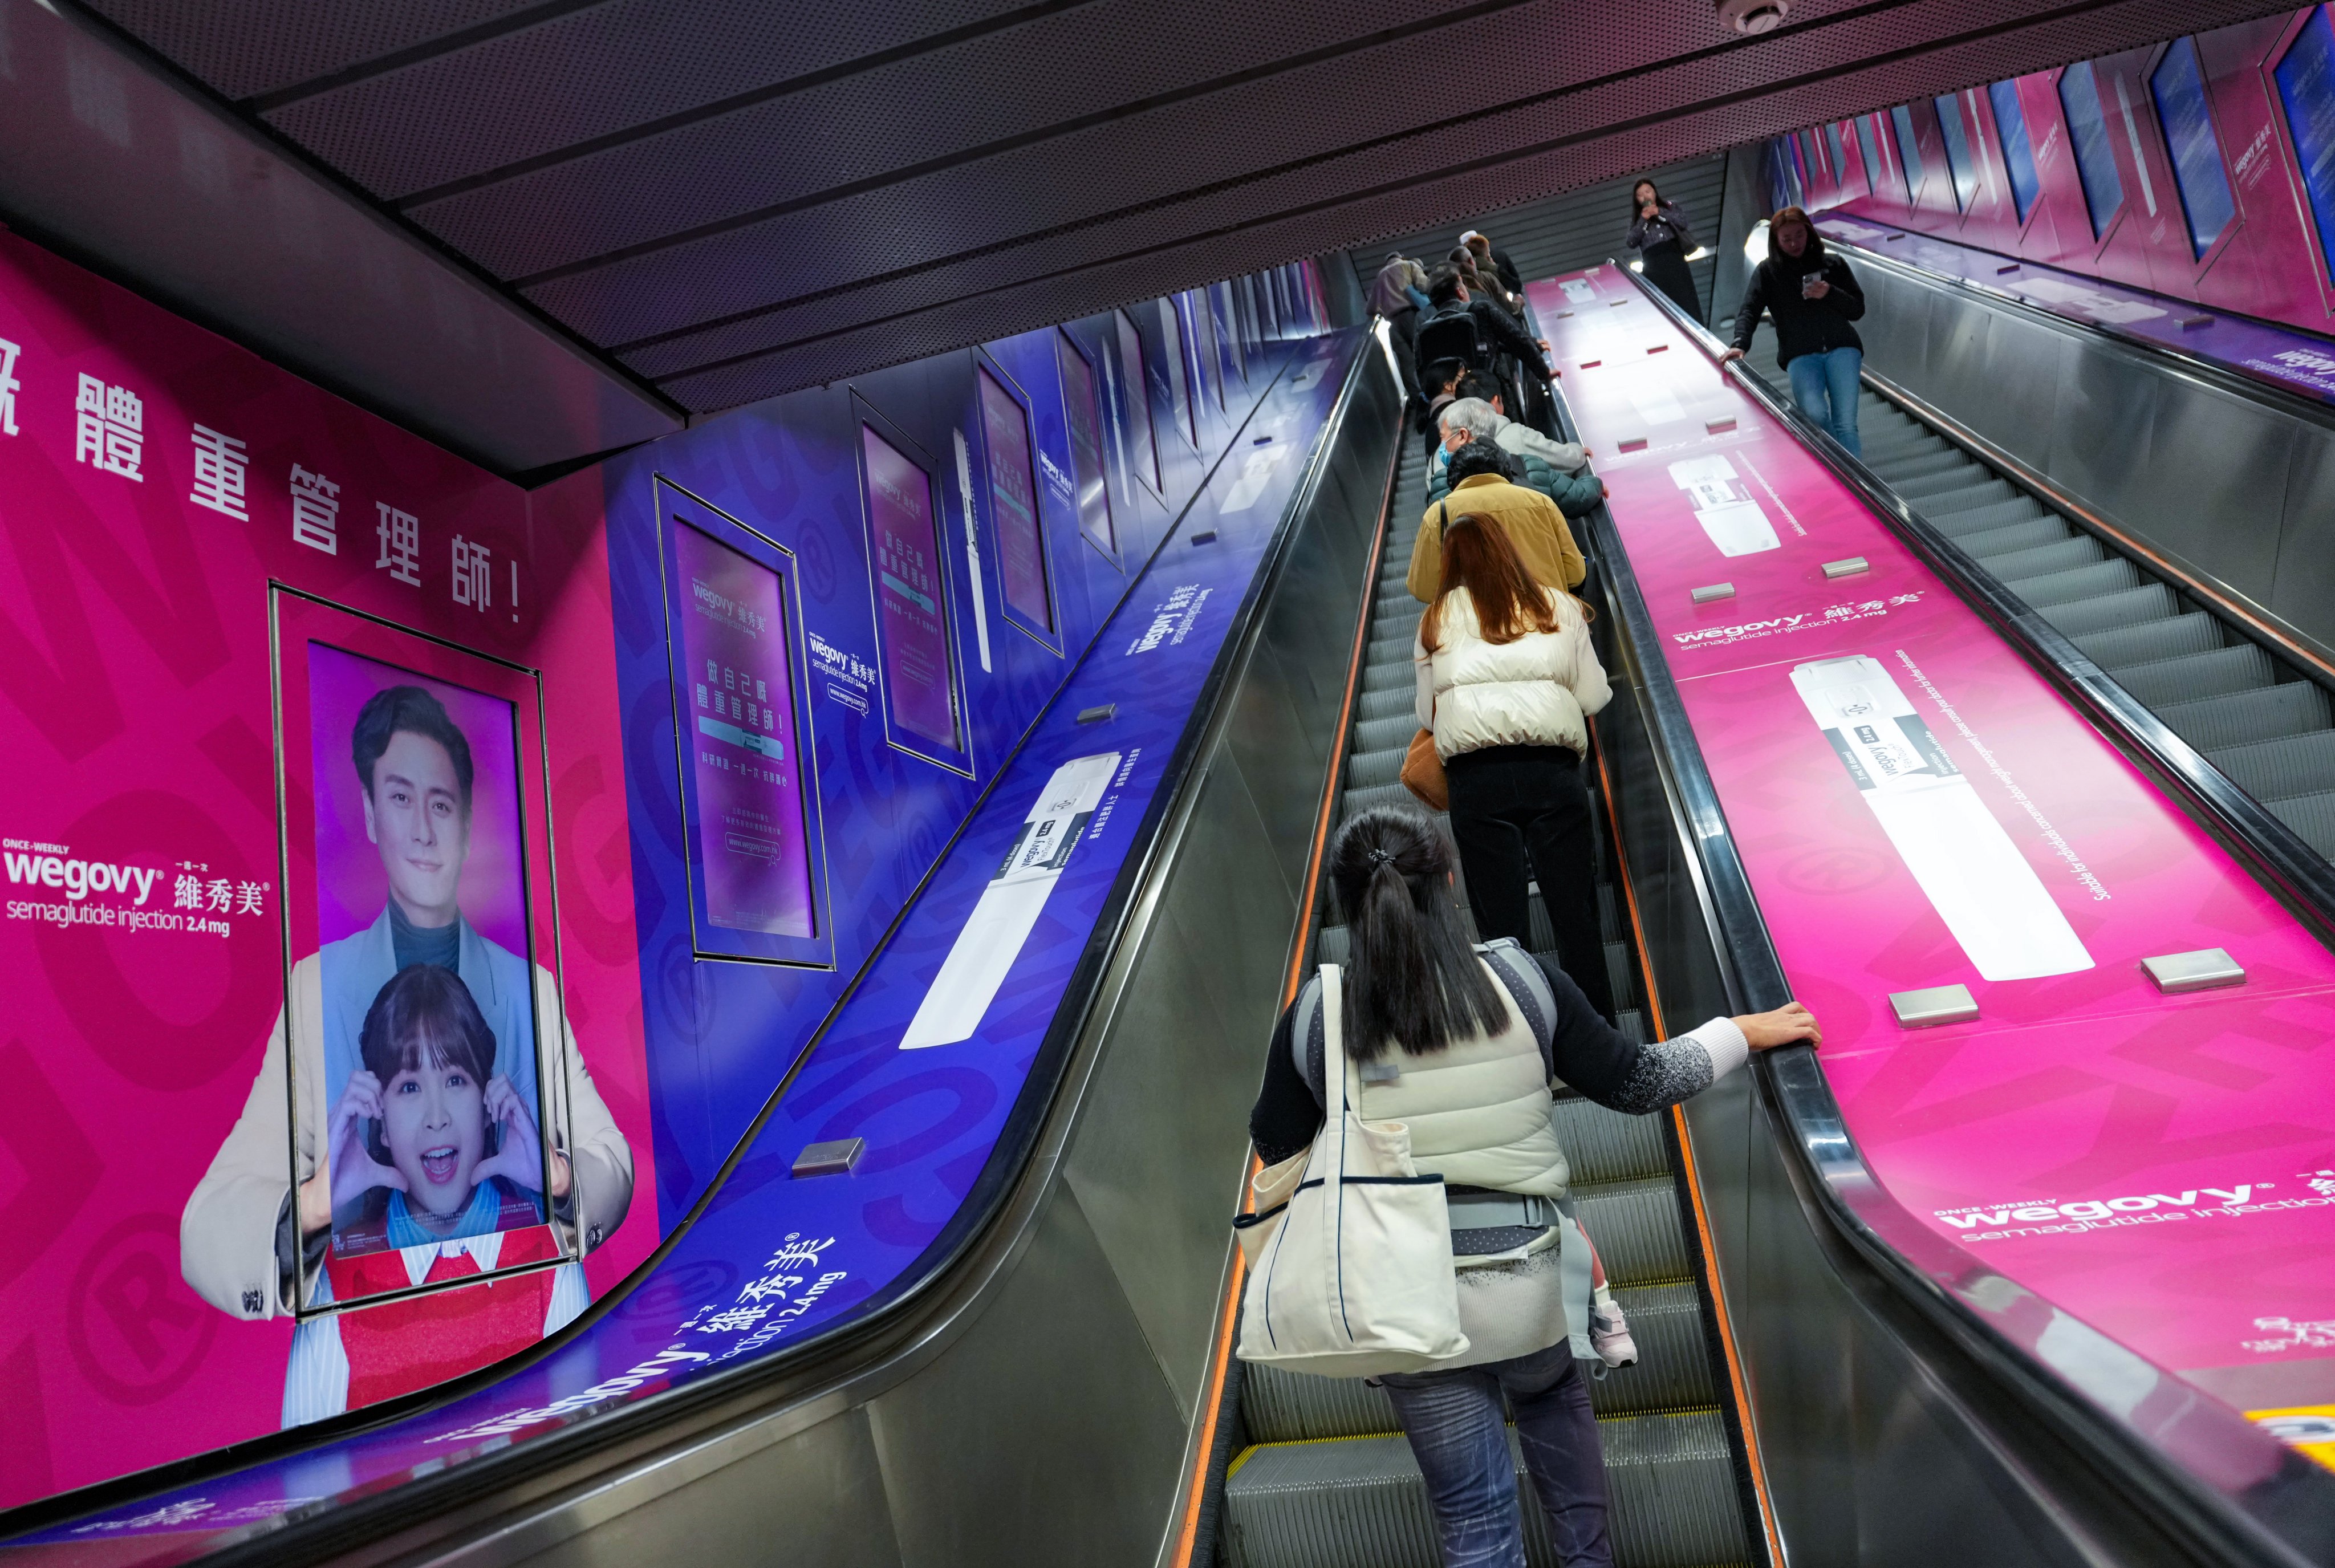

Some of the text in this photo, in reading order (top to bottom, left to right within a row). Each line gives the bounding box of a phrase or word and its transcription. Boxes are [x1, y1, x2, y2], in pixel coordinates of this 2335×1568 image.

[1672, 625, 1725, 638] ONCE-WEEKLY
[1680, 608, 1887, 651] semaglutide injection 2.4 mg
[1895, 649, 1917, 671] information
[813, 659, 839, 678] semaglutide
[838, 668, 855, 684] injection
[830, 688, 866, 709] www.wegovy.com.hk
[1939, 707, 1961, 723] consult
[1958, 722, 1978, 738] please
[1925, 730, 1960, 773] semaglutide
[1929, 753, 1950, 775] injection
[1990, 767, 2013, 786] weight
[2004, 785, 2027, 800] about
[2014, 801, 2052, 829] concerned
[3, 838, 70, 855] ONCE-WEEKLY
[729, 838, 778, 855] www.wegovy.com.hk
[1062, 826, 1085, 866] semaglutide
[2040, 829, 2080, 863] individuals
[1053, 847, 1067, 868] injection
[2070, 863, 2088, 872] for
[2076, 872, 2111, 900] Suitable
[6, 899, 230, 938] semaglutide injection 2.4 mg
[1934, 1199, 2057, 1217] ONCE-WEEKLY
[1960, 1212, 2189, 1242] semaglutide
[779, 1297, 818, 1317] 2.4
[805, 1272, 847, 1295] mg
